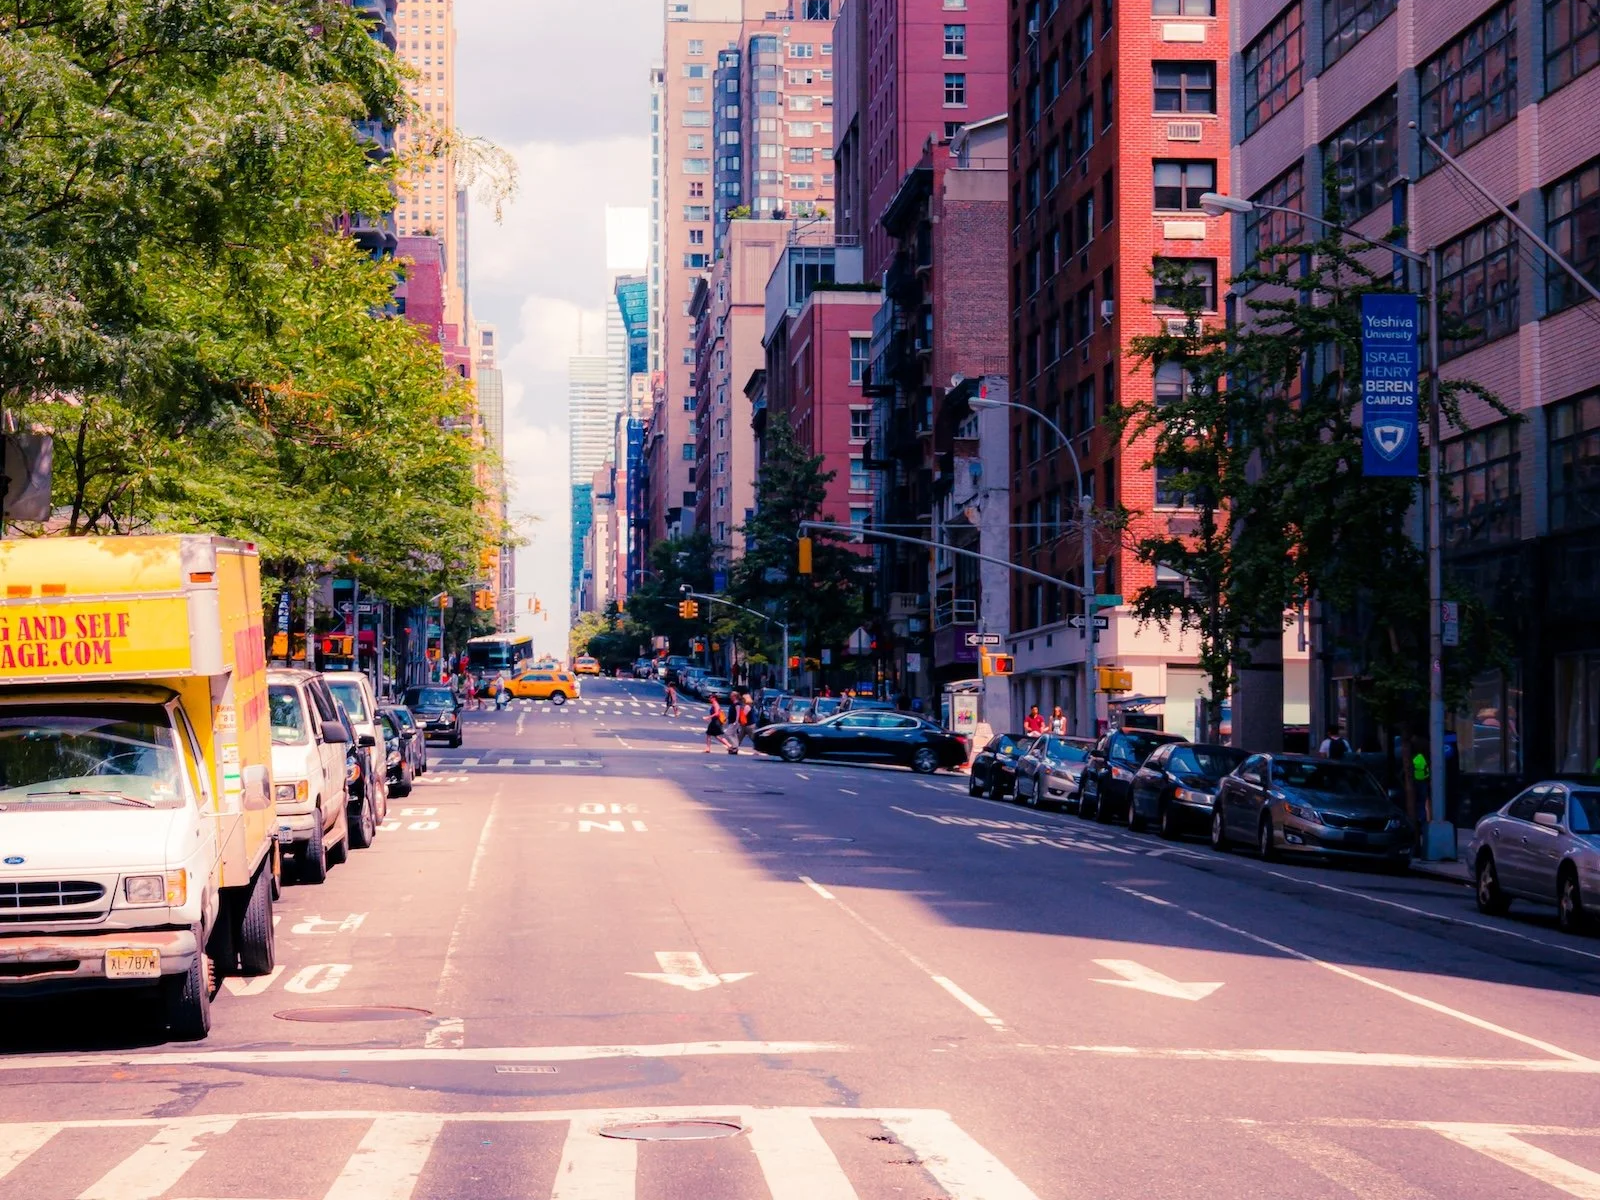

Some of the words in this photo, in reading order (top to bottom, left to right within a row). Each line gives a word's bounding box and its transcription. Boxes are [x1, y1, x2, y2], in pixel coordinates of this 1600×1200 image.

[1366, 315, 1413, 328] Yeshiva
[1365, 330, 1412, 341] University
[1366, 352, 1413, 363] ISRAEL
[1366, 366, 1411, 377] HENRY
[1366, 380, 1413, 392] BEREN
[1366, 395, 1413, 405] CAMPUS
[18, 616, 66, 640] AND
[75, 613, 130, 639] SELF
[1, 640, 112, 668] AGE.COM
